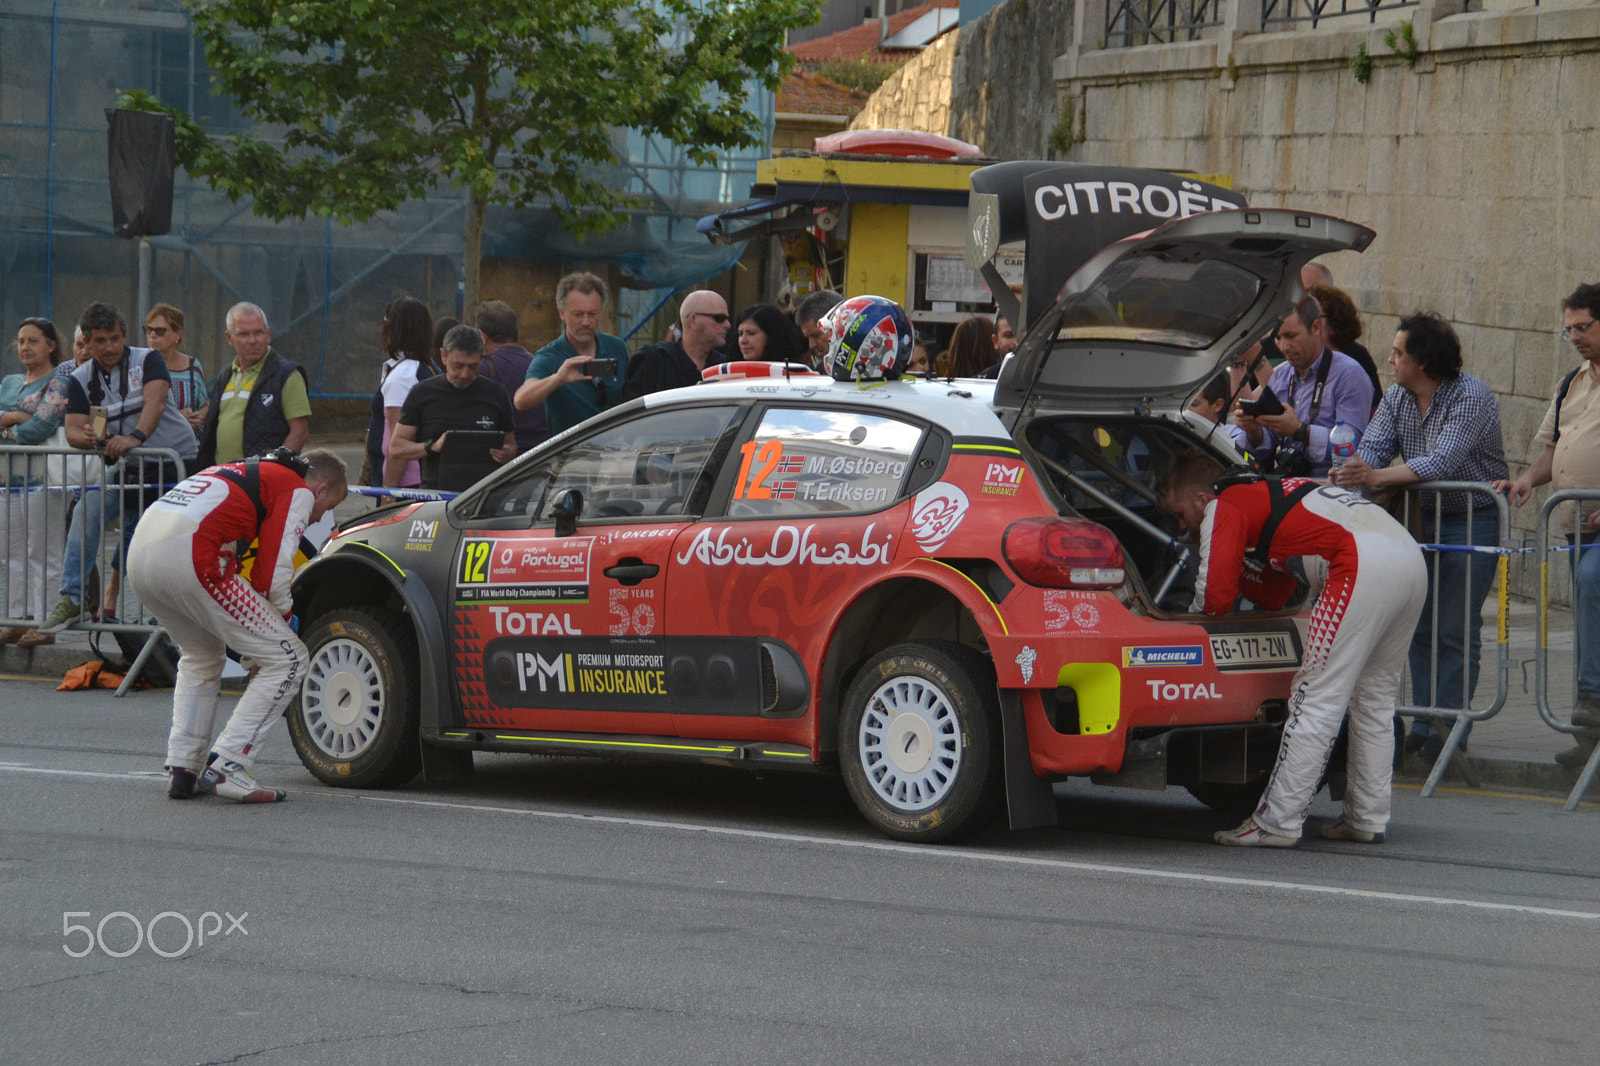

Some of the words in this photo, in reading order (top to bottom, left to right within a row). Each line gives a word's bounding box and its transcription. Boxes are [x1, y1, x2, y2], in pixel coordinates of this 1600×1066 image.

[733, 439, 783, 500] 12
[808, 456, 906, 480] M.Østberg
[985, 463, 1025, 484] PMI
[803, 482, 887, 501] T.Eriksen
[981, 486, 1018, 497] INSURANCE
[408, 520, 439, 538] PMI
[622, 528, 678, 540] ONEBET
[676, 526, 767, 566] Abu
[767, 522, 892, 566] Dhabi
[464, 541, 490, 582] 12
[521, 552, 585, 568] Portugal
[493, 566, 517, 574] vodafone
[491, 589, 505, 597] World
[506, 589, 519, 598] Rally
[520, 588, 556, 598] Championship
[631, 589, 655, 599] YEARS
[1070, 591, 1097, 600] YEARS
[1146, 652, 1197, 662] MICHELIN
[1213, 637, 1290, 660] EG-177-ZW
[578, 653, 611, 666] PREMIUM
[614, 654, 665, 668] MOTORSPORT
[516, 652, 576, 692] PMI
[579, 669, 668, 694] INSURANCE
